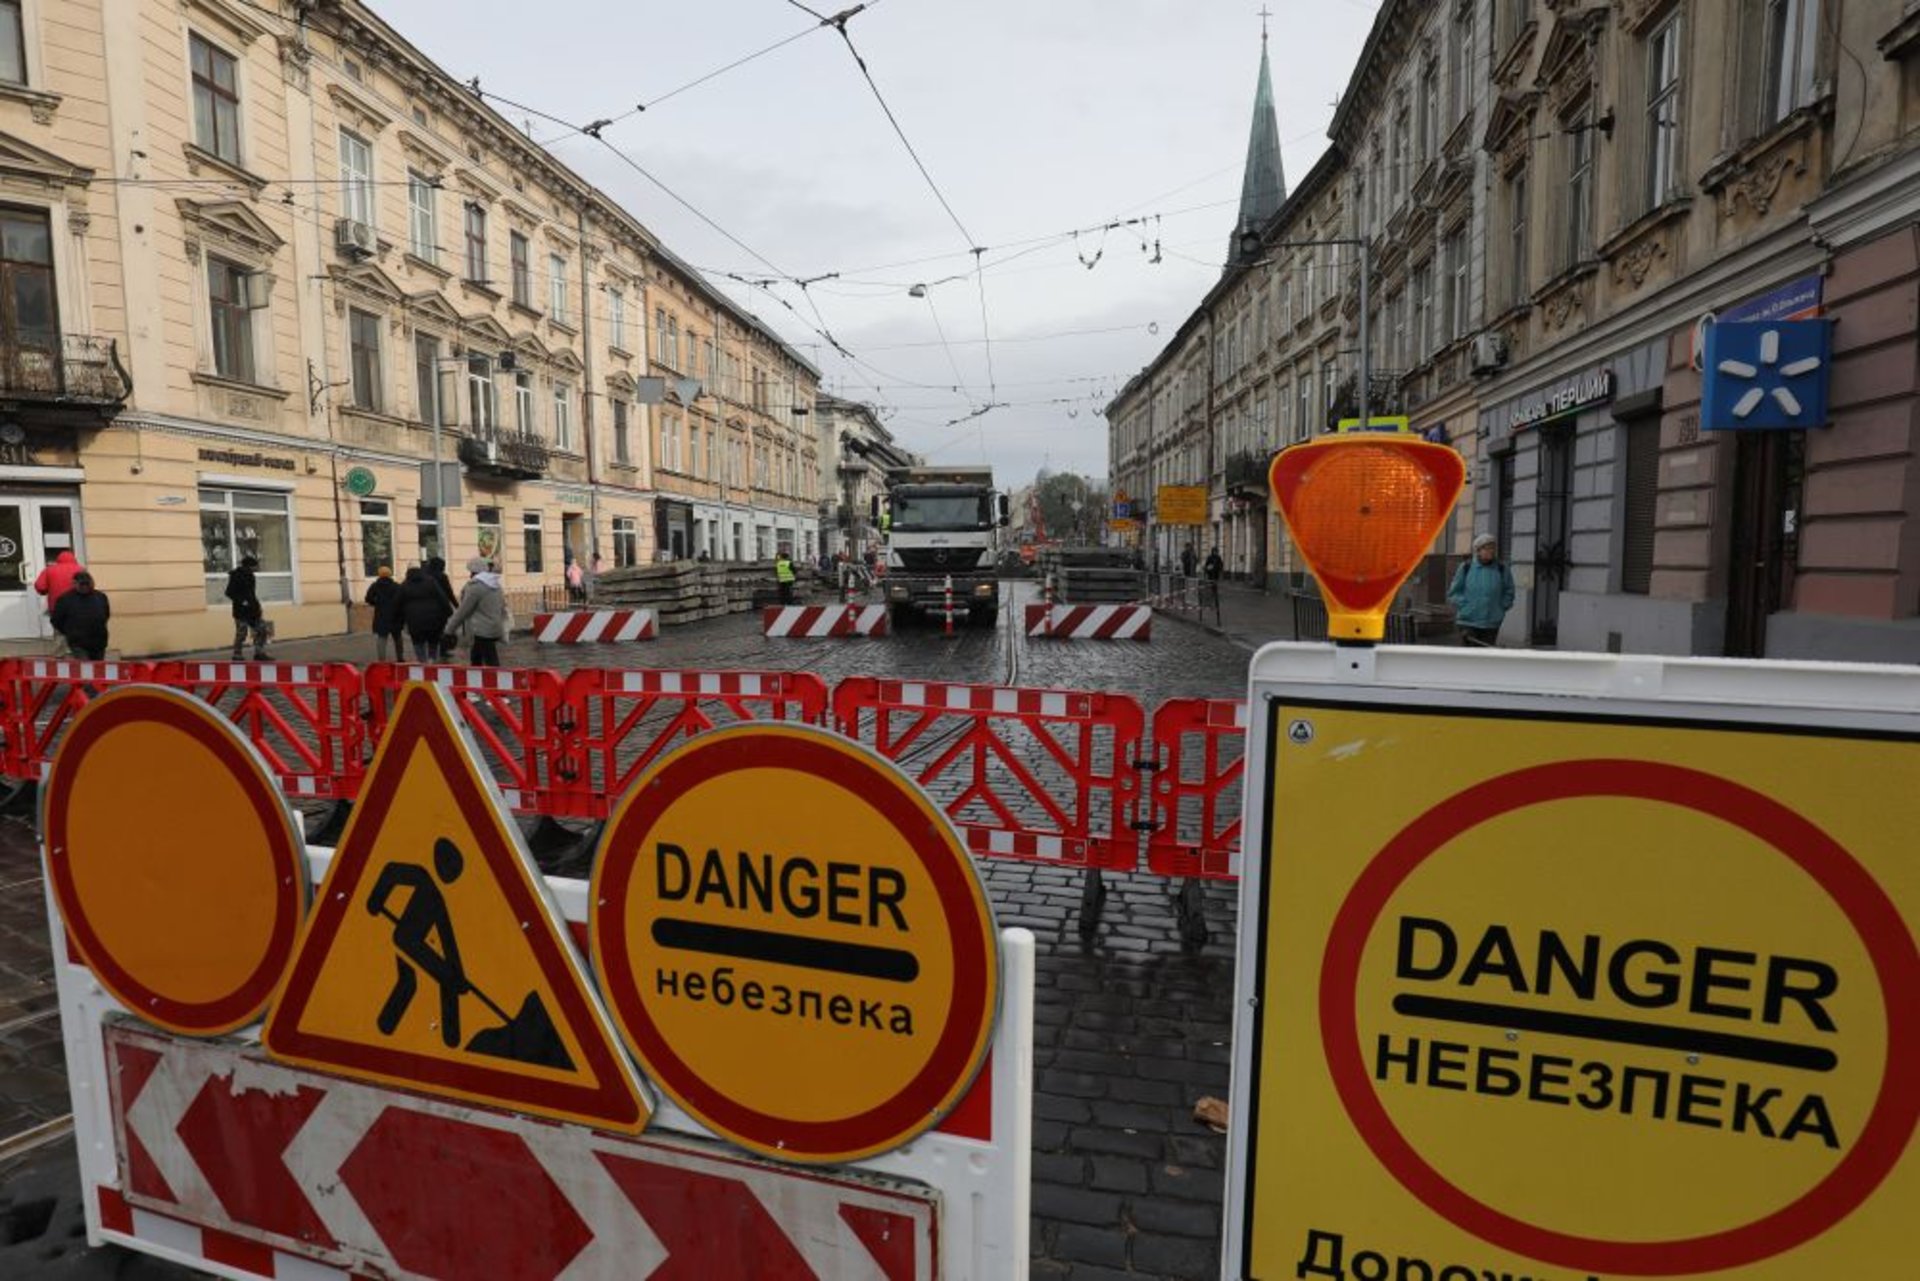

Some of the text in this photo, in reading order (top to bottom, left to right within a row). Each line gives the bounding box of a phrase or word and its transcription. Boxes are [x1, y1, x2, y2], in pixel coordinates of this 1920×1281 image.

[656, 843, 908, 931] DANGER
[657, 967, 914, 1035] небезпека
[1396, 916, 1838, 1033] DANGER
[1376, 1034, 1840, 1149] НЕБЕЗПЕКА
